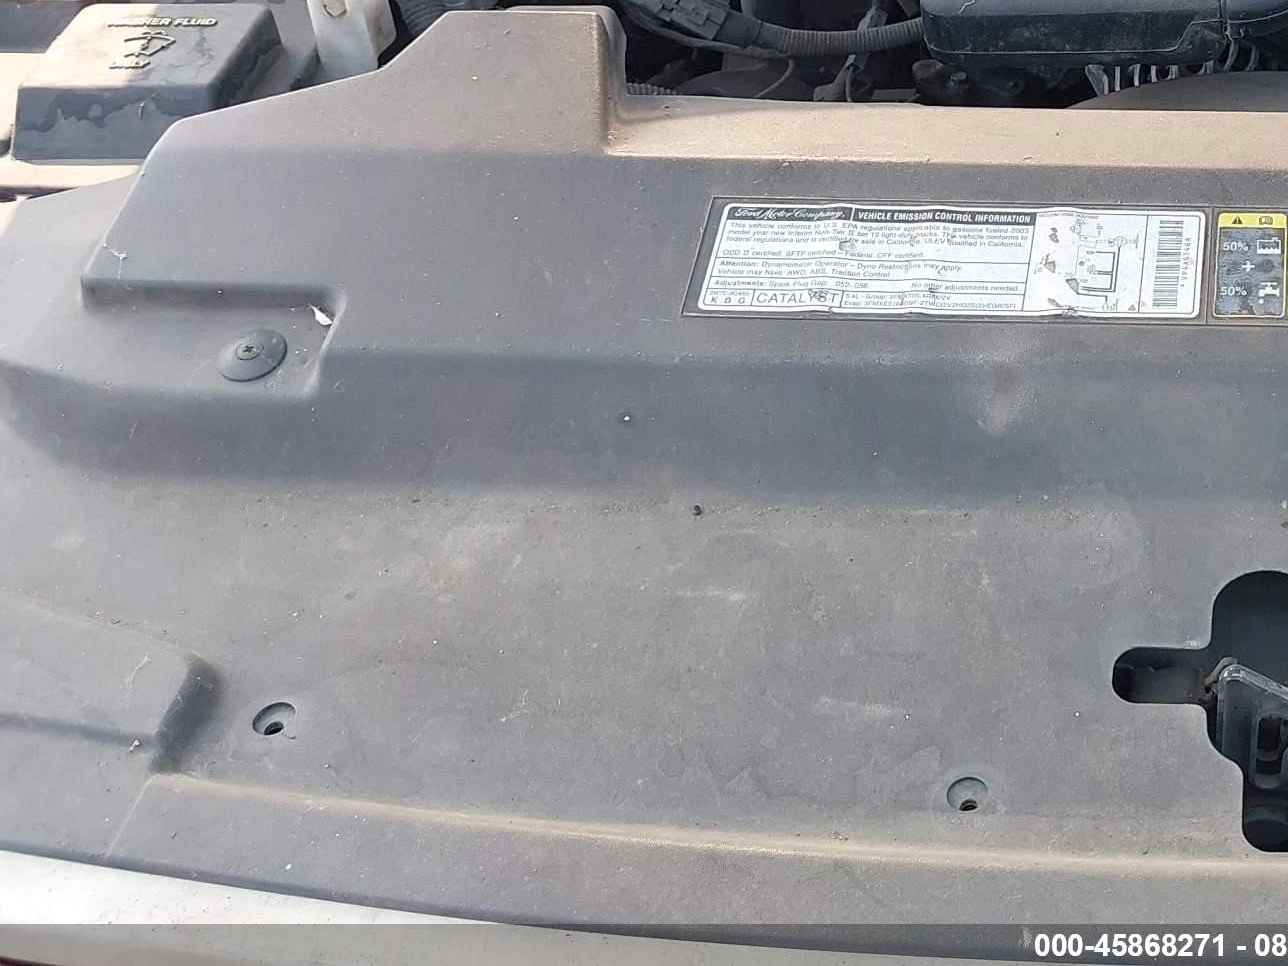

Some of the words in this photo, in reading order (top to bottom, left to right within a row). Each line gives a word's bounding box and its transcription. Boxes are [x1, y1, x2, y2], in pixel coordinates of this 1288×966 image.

[173, 18, 217, 27] FLUID
[734, 208, 761, 218] Ford
[758, 208, 792, 220] Motor
[858, 211, 892, 221] VEHICLE
[893, 212, 933, 221] EMISSION
[934, 212, 973, 222] CONTROL
[974, 213, 1031, 223] INFORMATION
[860, 224, 901, 232] regulations
[952, 226, 983, 234] gasoline
[1222, 241, 1249, 252] 50%
[814, 260, 849, 268] Operator
[856, 262, 877, 271] Dyno
[923, 263, 938, 271] may
[831, 268, 861, 277] Traction
[714, 279, 767, 287] Adjustments:
[768, 280, 791, 288] Spark
[792, 280, 809, 288] Plug
[944, 284, 989, 292] adjustments
[1220, 286, 1248, 297] 50%
[756, 291, 840, 304] CATALYST
